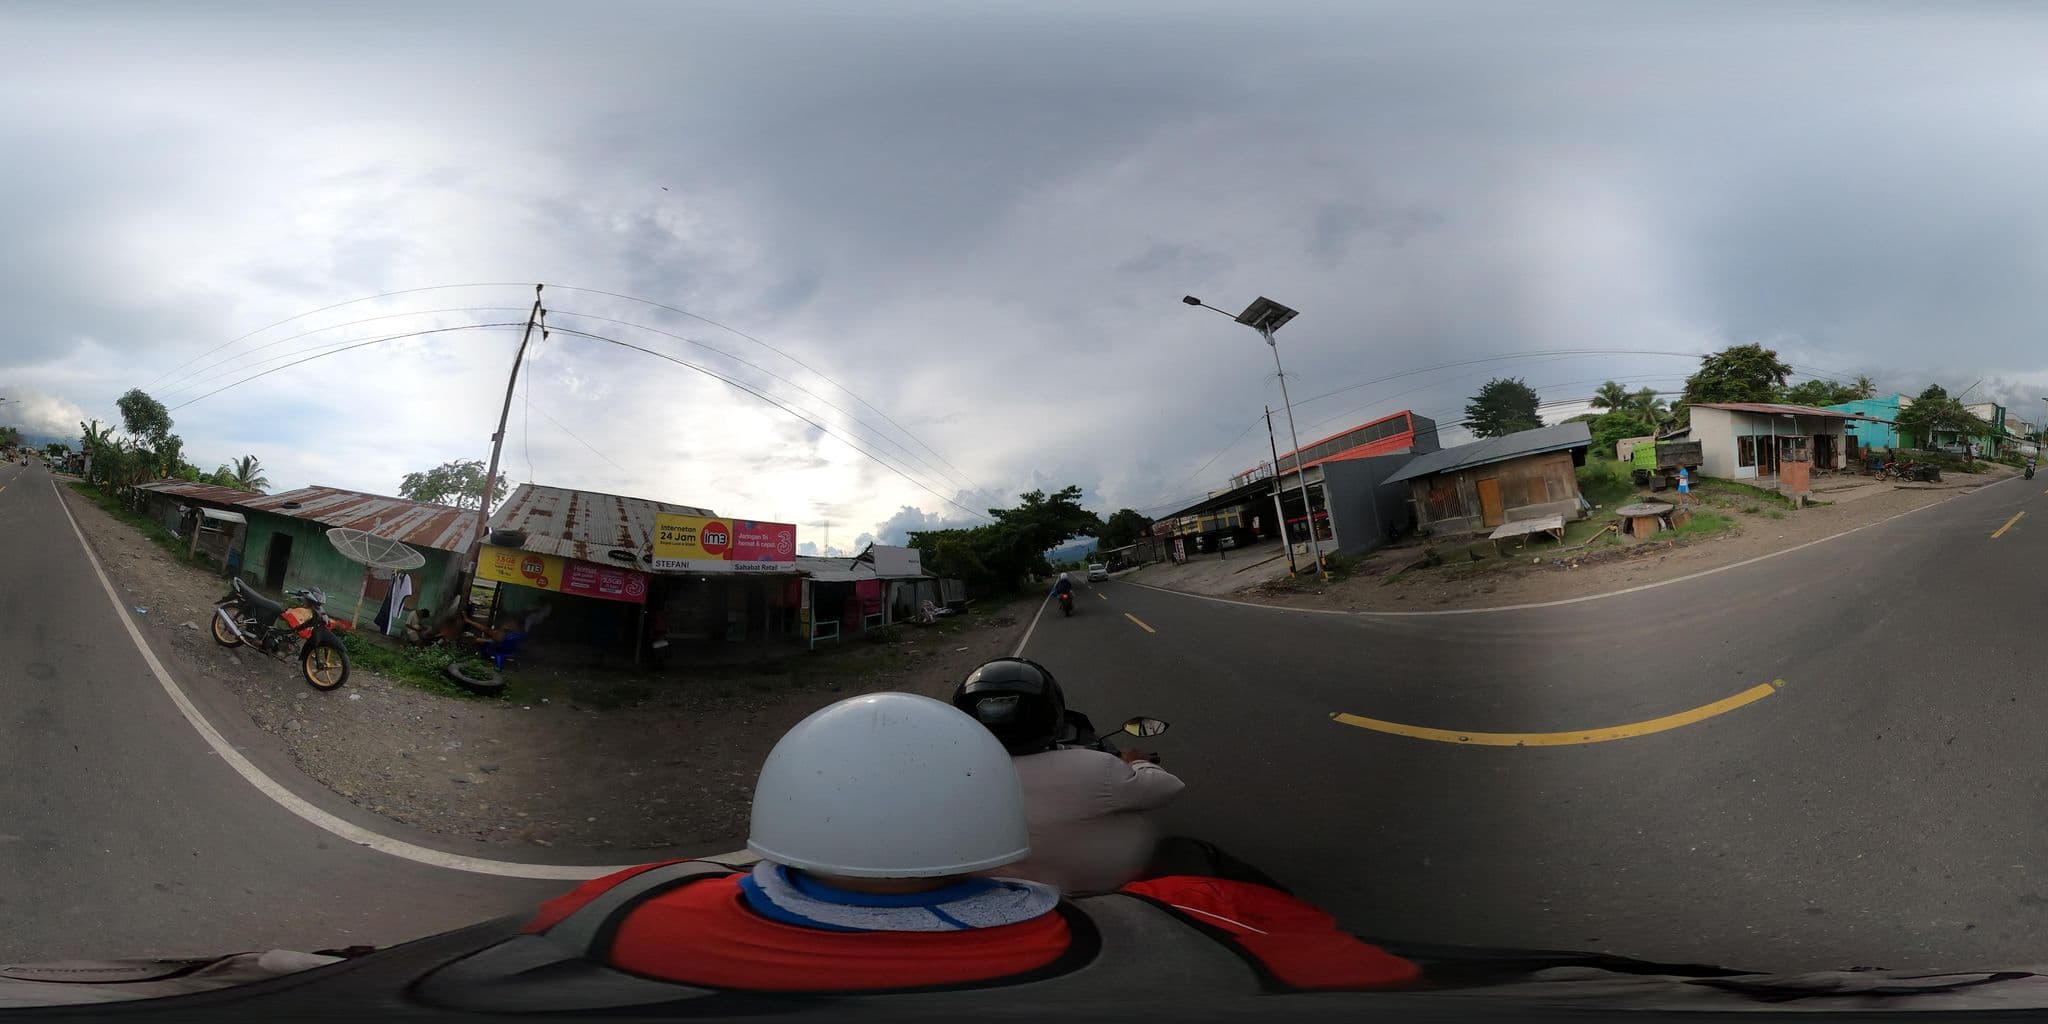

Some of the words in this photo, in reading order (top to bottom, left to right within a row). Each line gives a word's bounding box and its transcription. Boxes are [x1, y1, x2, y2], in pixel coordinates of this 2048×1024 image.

[661, 525, 697, 533] Internetan
[661, 532, 672, 540] 24
[674, 532, 696, 541] Jam
[656, 560, 690, 569] STEFANI
